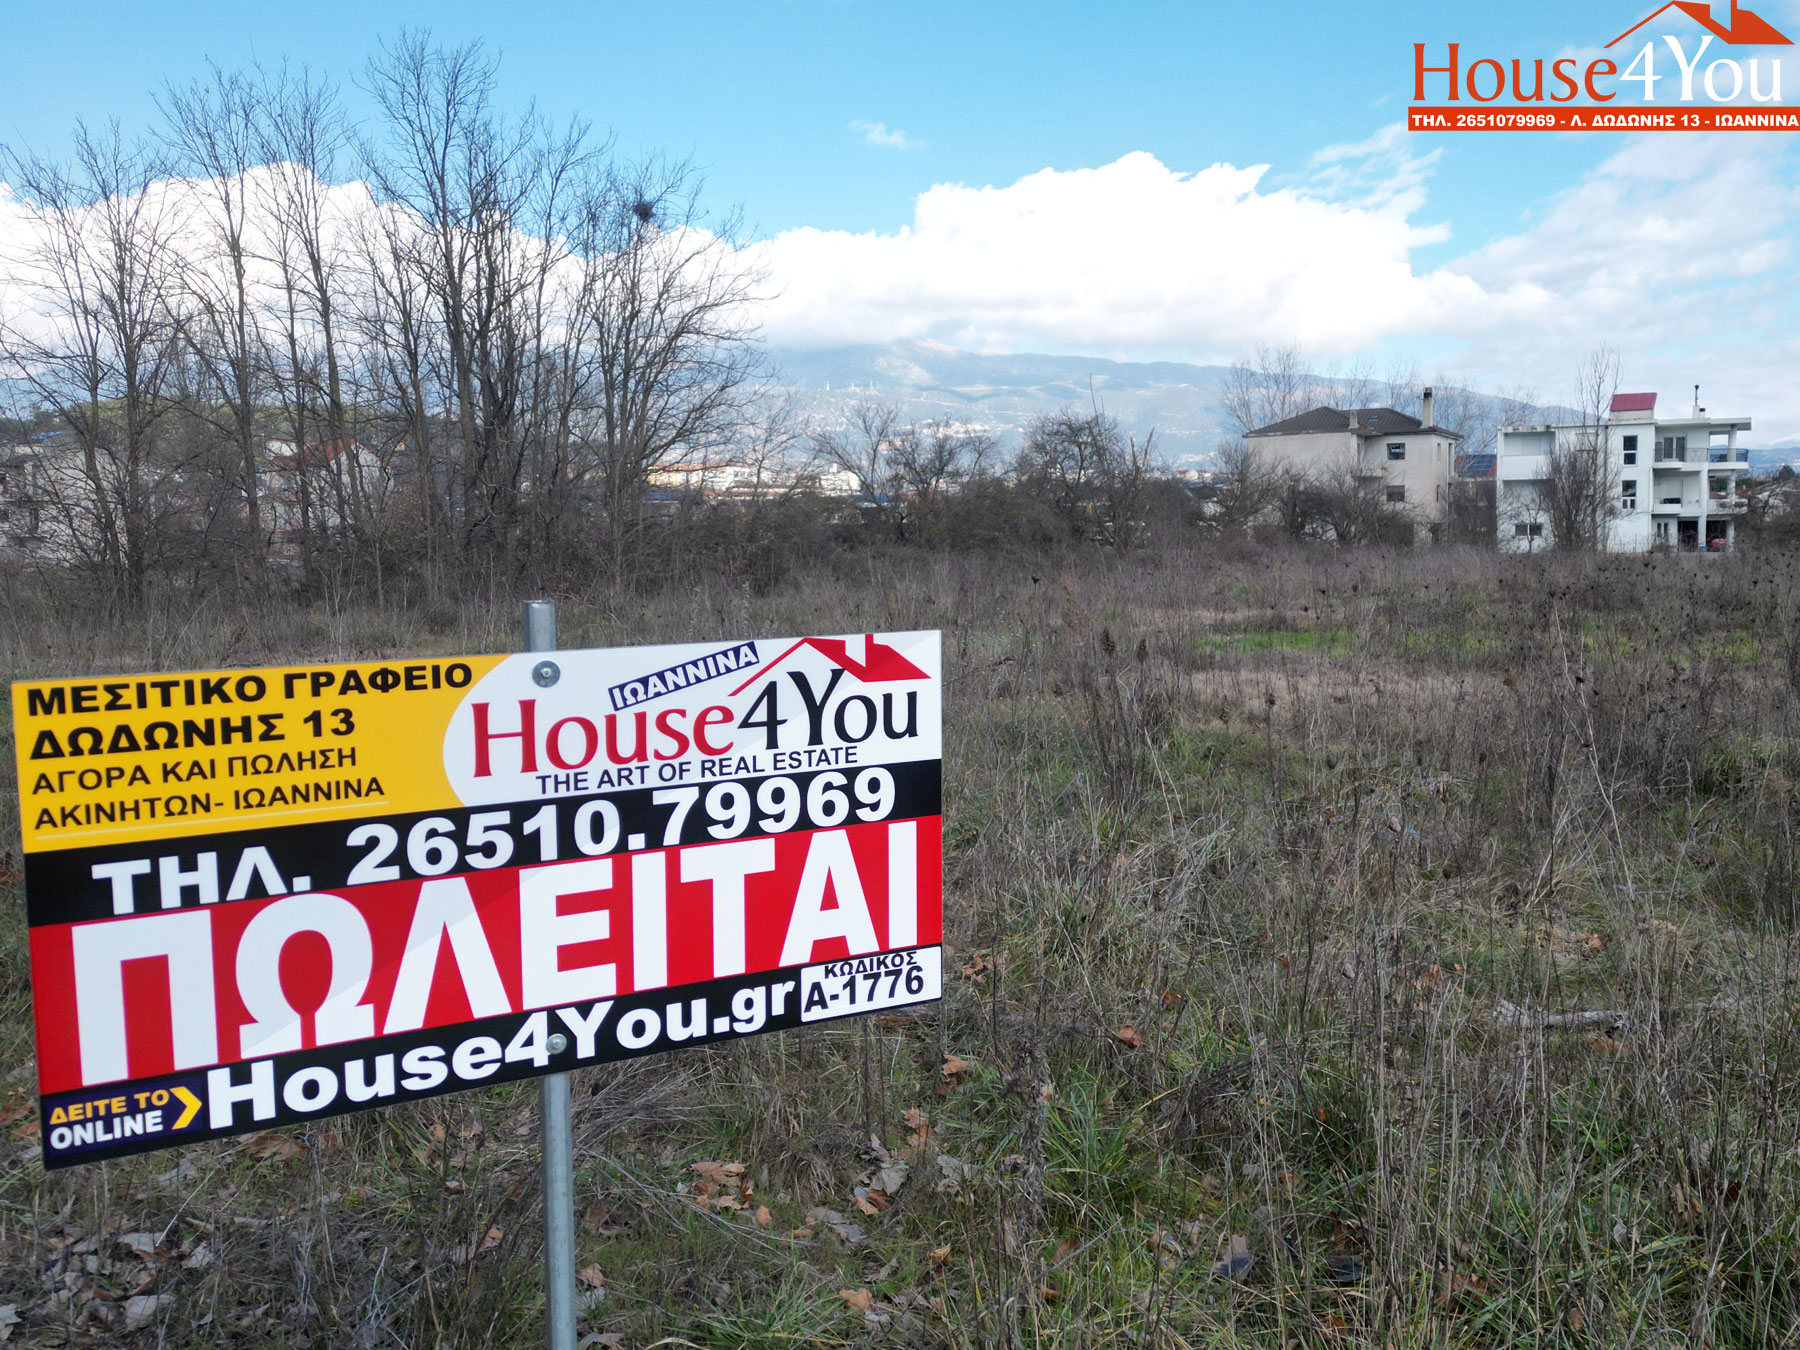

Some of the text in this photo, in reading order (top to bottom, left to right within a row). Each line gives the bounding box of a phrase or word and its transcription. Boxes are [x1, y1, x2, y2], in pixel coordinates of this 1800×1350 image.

[27, 662, 473, 717] ΜΕΣΙΤΙΚΟ ΓΡΑΦΕΙΟ
[612, 643, 758, 706] ΙΩΑΝΝΙΝΑ
[29, 708, 356, 760] ΔΩΔΩΝΗΣ 13
[471, 668, 919, 778] House4You
[32, 747, 357, 795] ΑΓΟΡΑ ΚΑΙ ΠΩΛΗΣΗ
[233, 776, 386, 810] ΙΩΑΝΝΙΝΑ
[536, 745, 858, 795] THE ART OF REAL ESTATE
[91, 766, 896, 915] ΤΗΛ. 26510.79969
[71, 821, 917, 1087] ΠΩΛΕΙΤΑΙ
[823, 951, 918, 979] ΚΩΔΙΚΟΣ
[207, 980, 795, 1130] House4You.gr
[49, 1089, 170, 1125] ΔΕΙΤΕ ΤΟ
[49, 1110, 163, 1150] ONLINE
